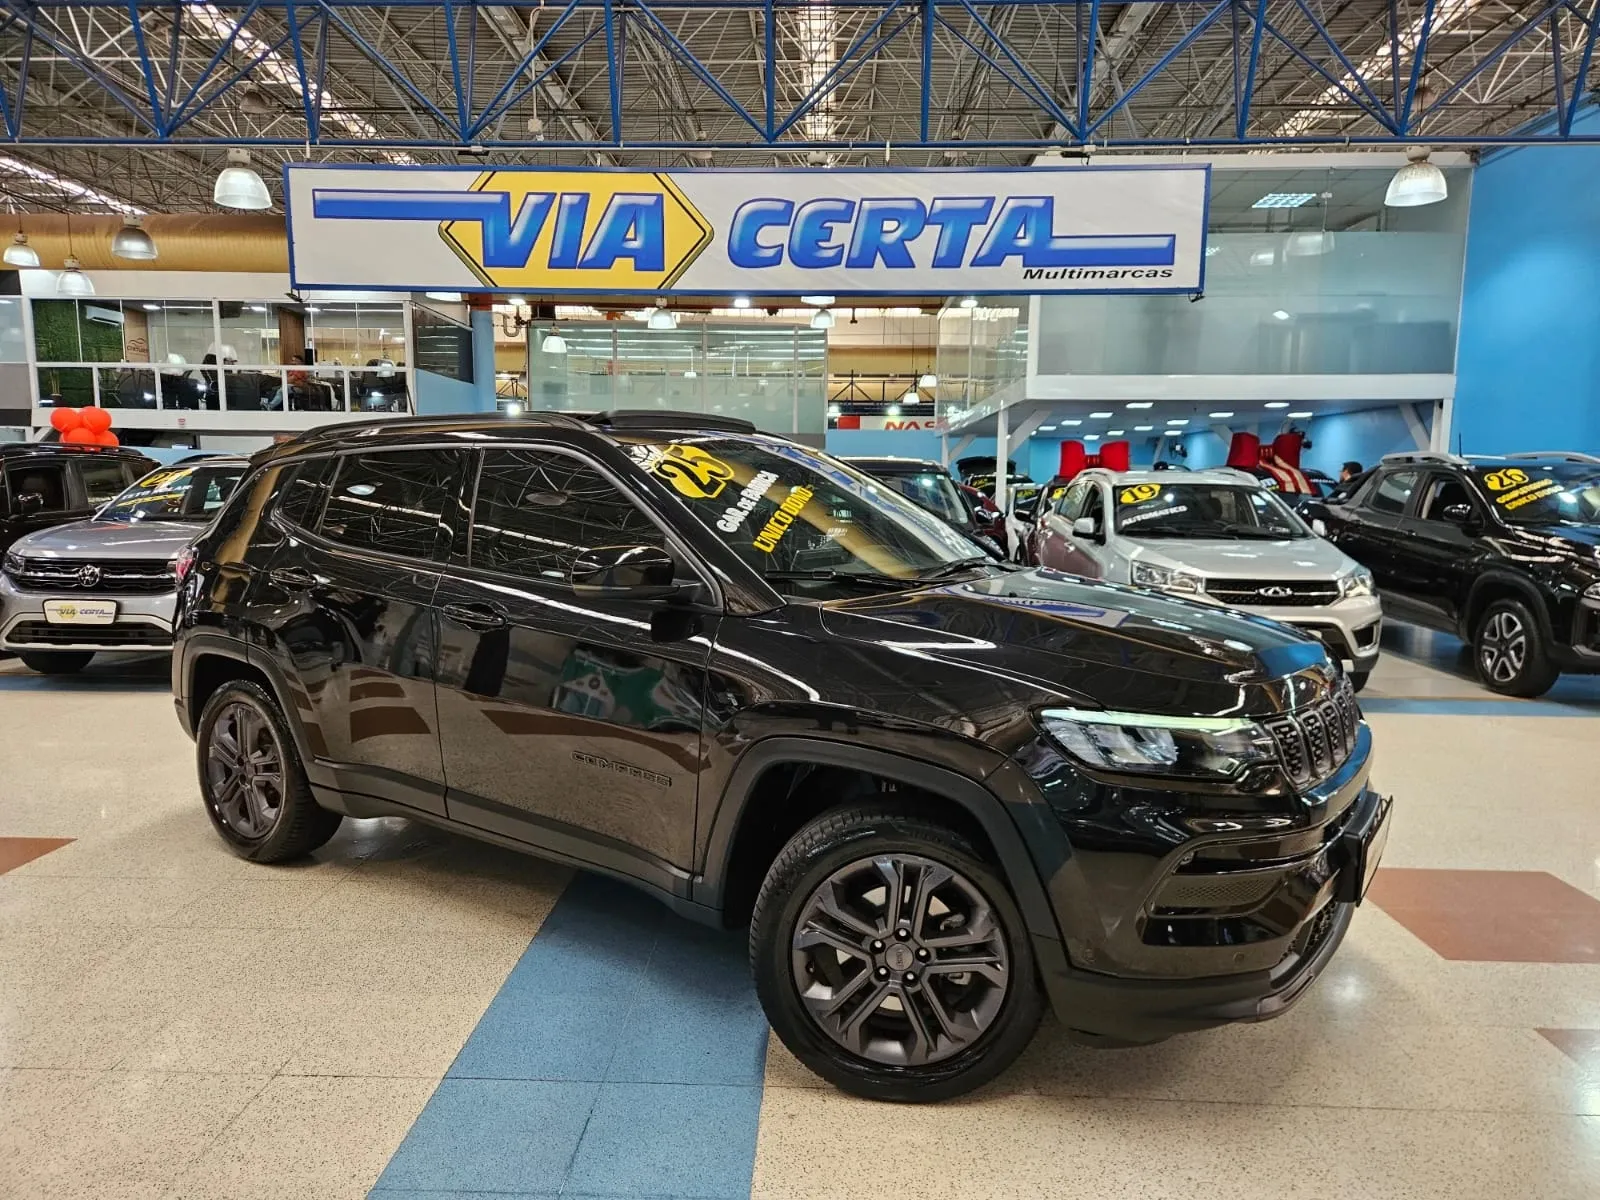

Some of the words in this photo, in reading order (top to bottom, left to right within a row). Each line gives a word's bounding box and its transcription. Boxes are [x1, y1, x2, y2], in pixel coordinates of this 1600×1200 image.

[474, 190, 665, 272] VIA
[727, 195, 1056, 269] CERTA
[1023, 266, 1174, 280] Multimarcas
[653, 445, 734, 498] 25
[1484, 469, 1529, 490] 26
[736, 496, 756, 510] DE
[779, 486, 814, 516] DONO
[1120, 484, 1161, 503] 19
